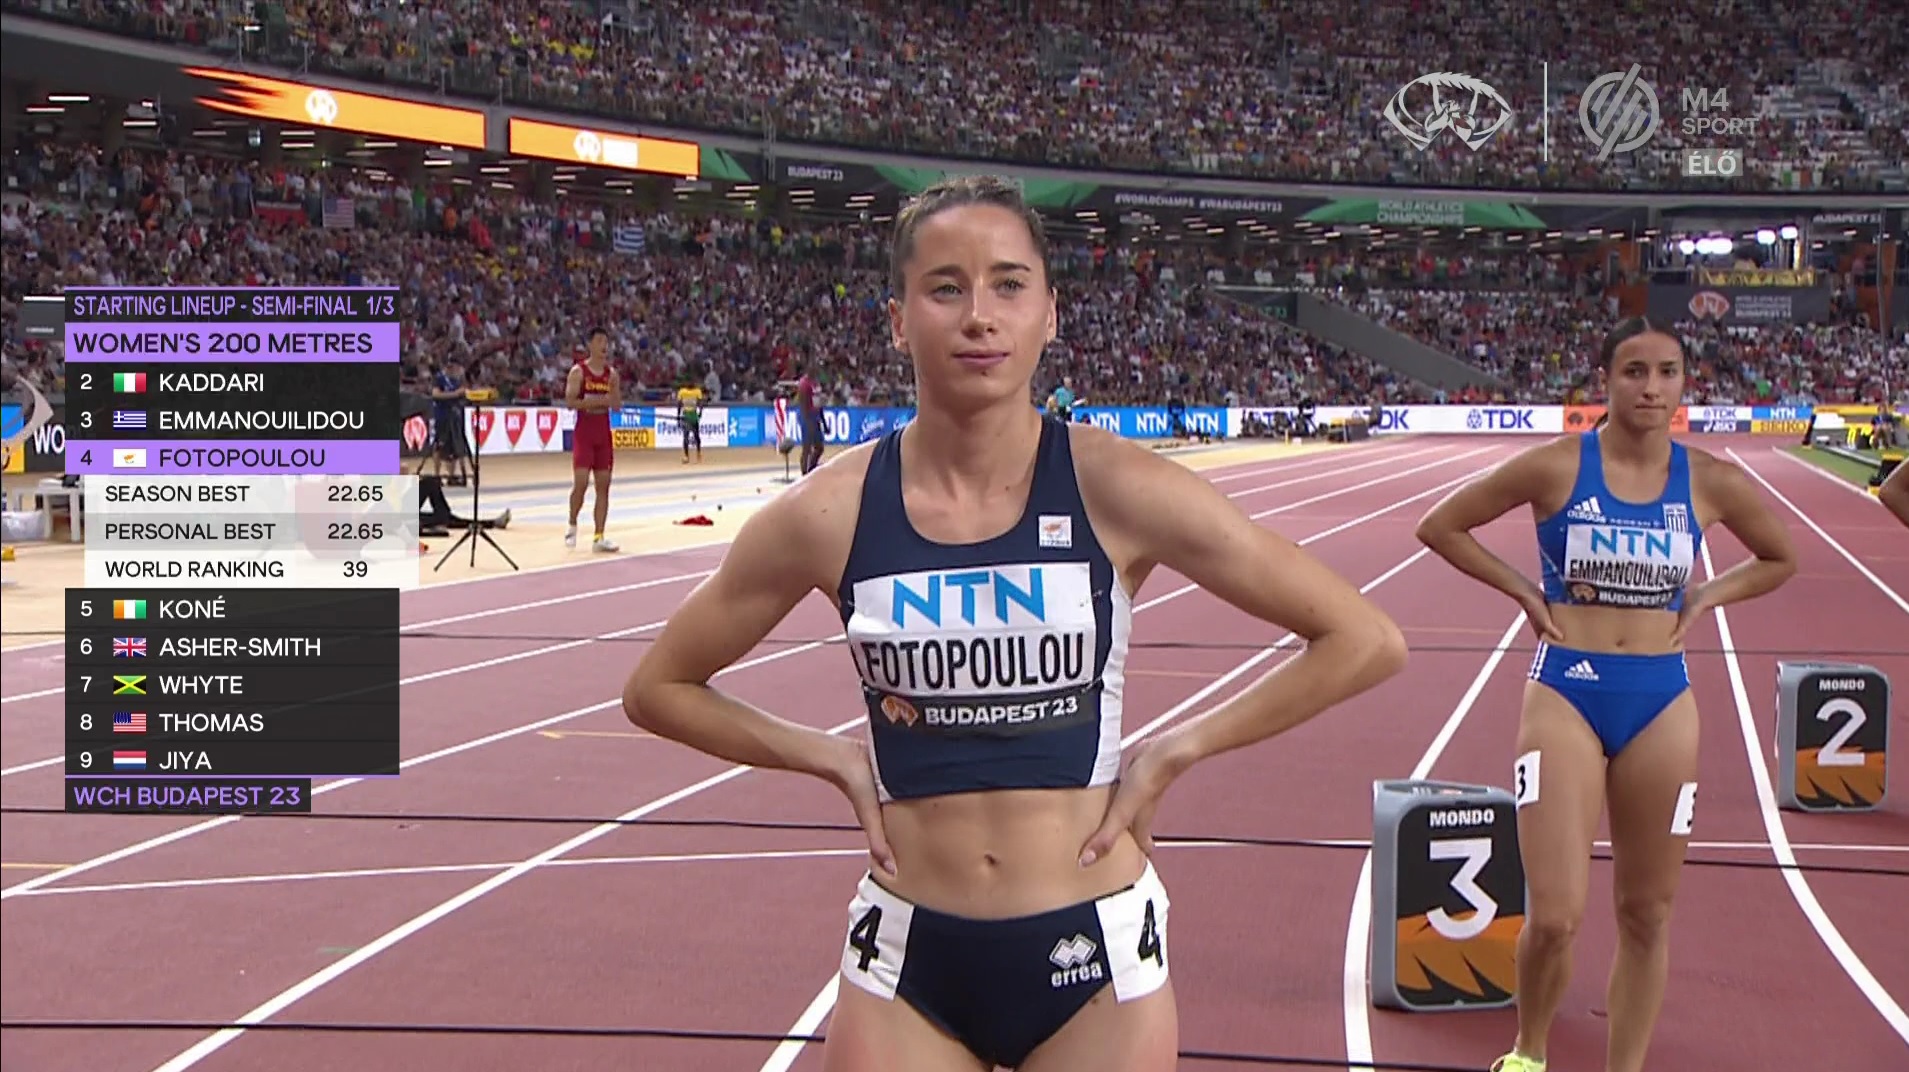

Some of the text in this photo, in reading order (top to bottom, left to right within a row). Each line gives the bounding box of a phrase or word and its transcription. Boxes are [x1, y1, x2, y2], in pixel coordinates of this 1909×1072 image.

[1136, 412, 1168, 434] NTN
[1185, 412, 1219, 433] NTN
[1482, 408, 1534, 430] TDK
[1760, 420, 1806, 432] SEIKO
[1770, 408, 1796, 419] NTN
[614, 429, 650, 447] SEIKO
[1590, 527, 1671, 560] NTN
[891, 567, 1046, 629] NTN
[859, 631, 1084, 690] FOTOPOULOU
[1818, 678, 1866, 692] MONDO
[924, 696, 1078, 726] BUDAPEST 23
[1816, 698, 1867, 767] 2
[1517, 764, 1526, 800] 3
[1429, 808, 1495, 827] MONDO
[1426, 837, 1498, 940] 3
[850, 905, 883, 973] 4
[1137, 898, 1164, 969] 4
